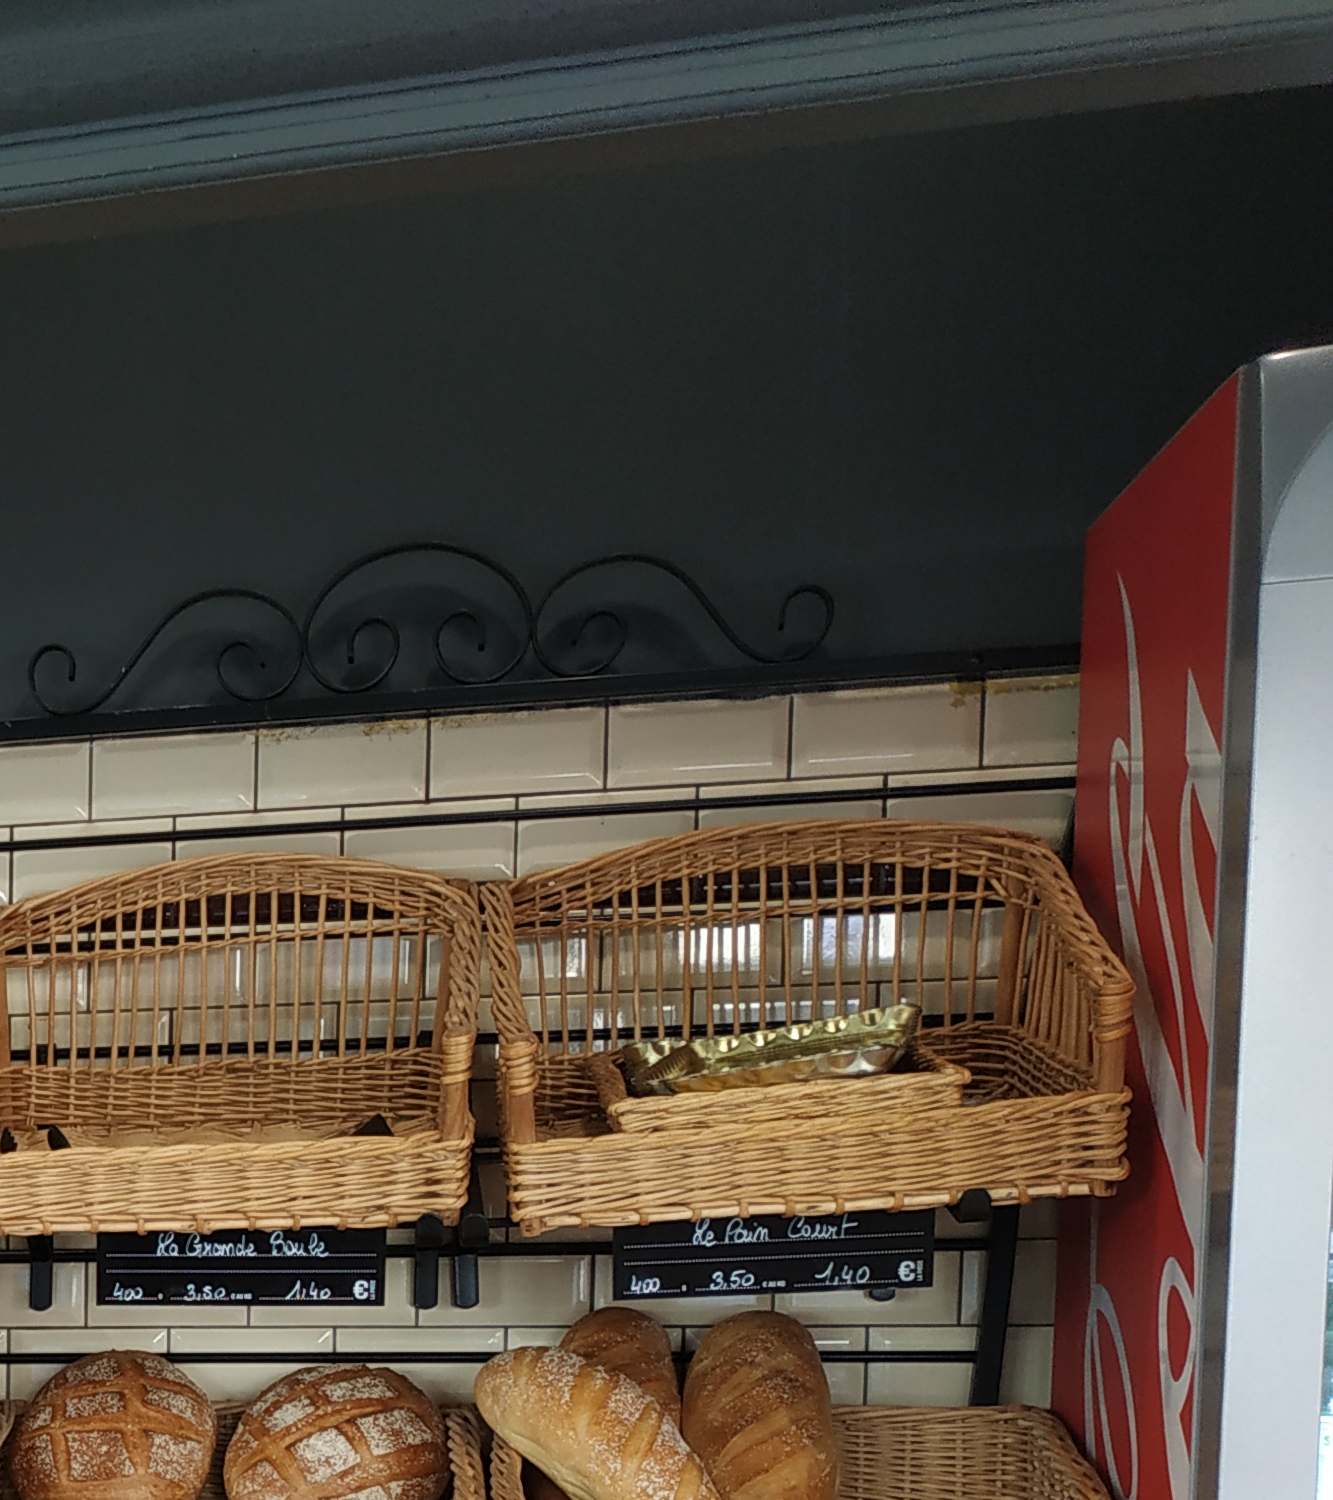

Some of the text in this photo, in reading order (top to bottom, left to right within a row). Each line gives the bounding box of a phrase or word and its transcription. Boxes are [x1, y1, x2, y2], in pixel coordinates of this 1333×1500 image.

[156, 1231, 330, 1258] La Grande Boule
[693, 1214, 859, 1246] Le Pain Court
[113, 1282, 144, 1300] 400
[184, 1283, 226, 1302] 3,50
[285, 1280, 332, 1301] 1,40
[353, 1280, 369, 1300] €
[630, 1261, 916, 1293] 400 3,50 1,40 €
